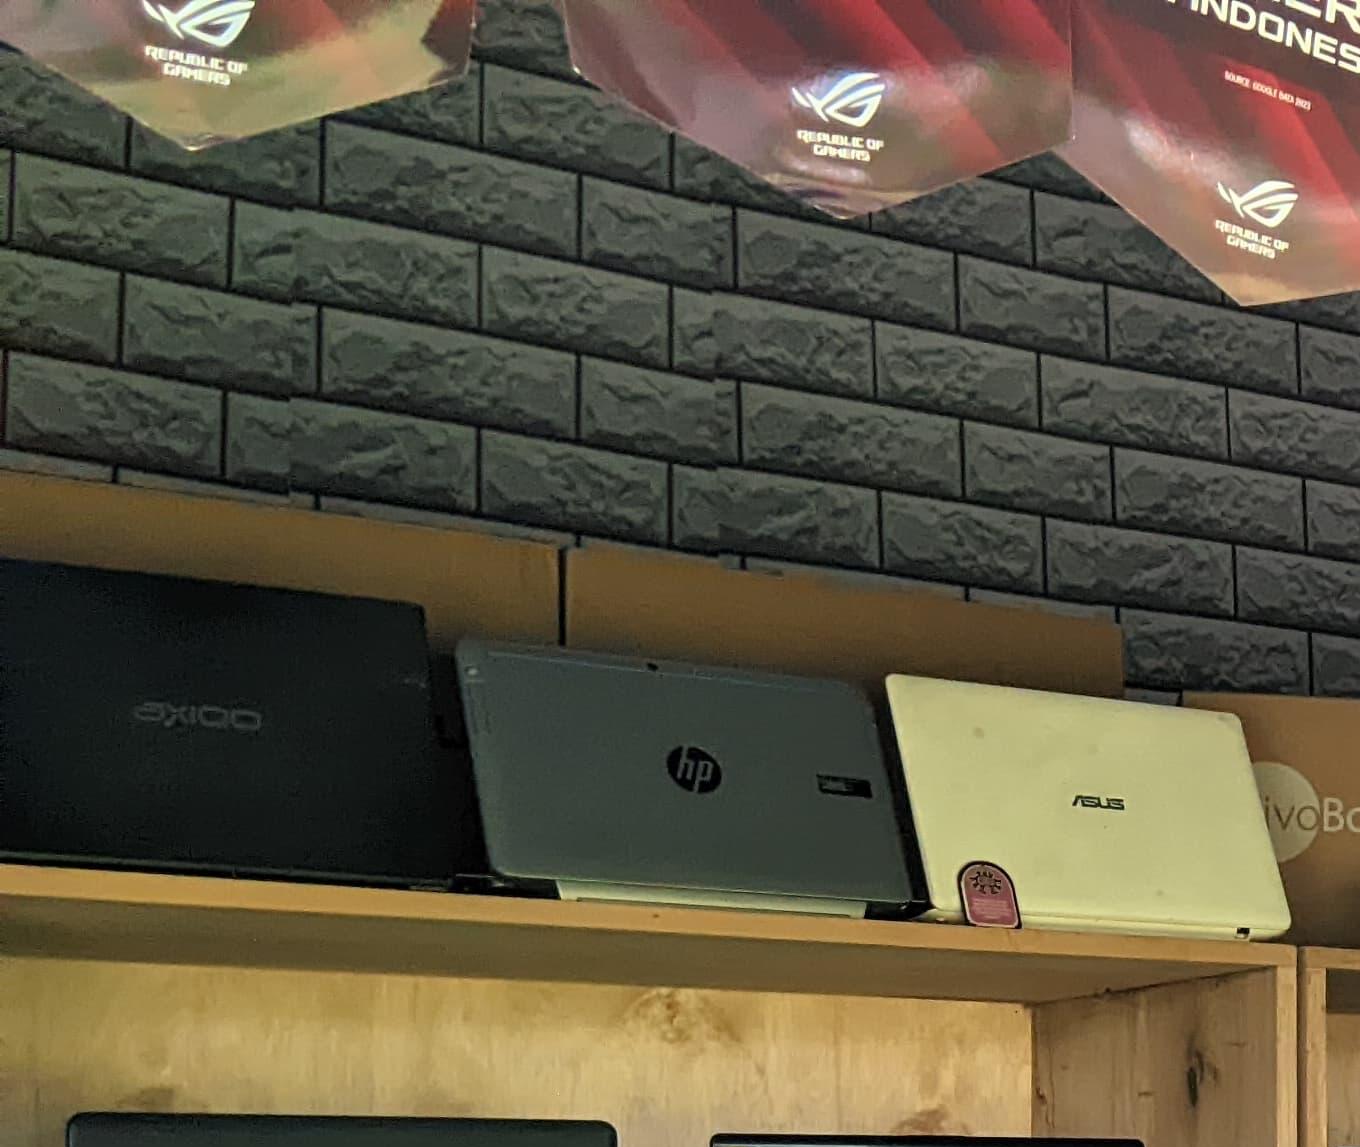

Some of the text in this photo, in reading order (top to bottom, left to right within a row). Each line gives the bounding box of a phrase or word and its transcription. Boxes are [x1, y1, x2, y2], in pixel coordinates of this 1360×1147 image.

[144, 45, 248, 75] REPUBLIC OF
[163, 62, 231, 86] GAMERS
[797, 129, 885, 151] REPUBLIC OF
[813, 144, 871, 162] GAMERS
[1215, 219, 1289, 253] REPUBLIC OF
[1227, 235, 1276, 260] GAMERS
[672, 745, 718, 793] hp
[1071, 794, 1126, 812] ASUS
